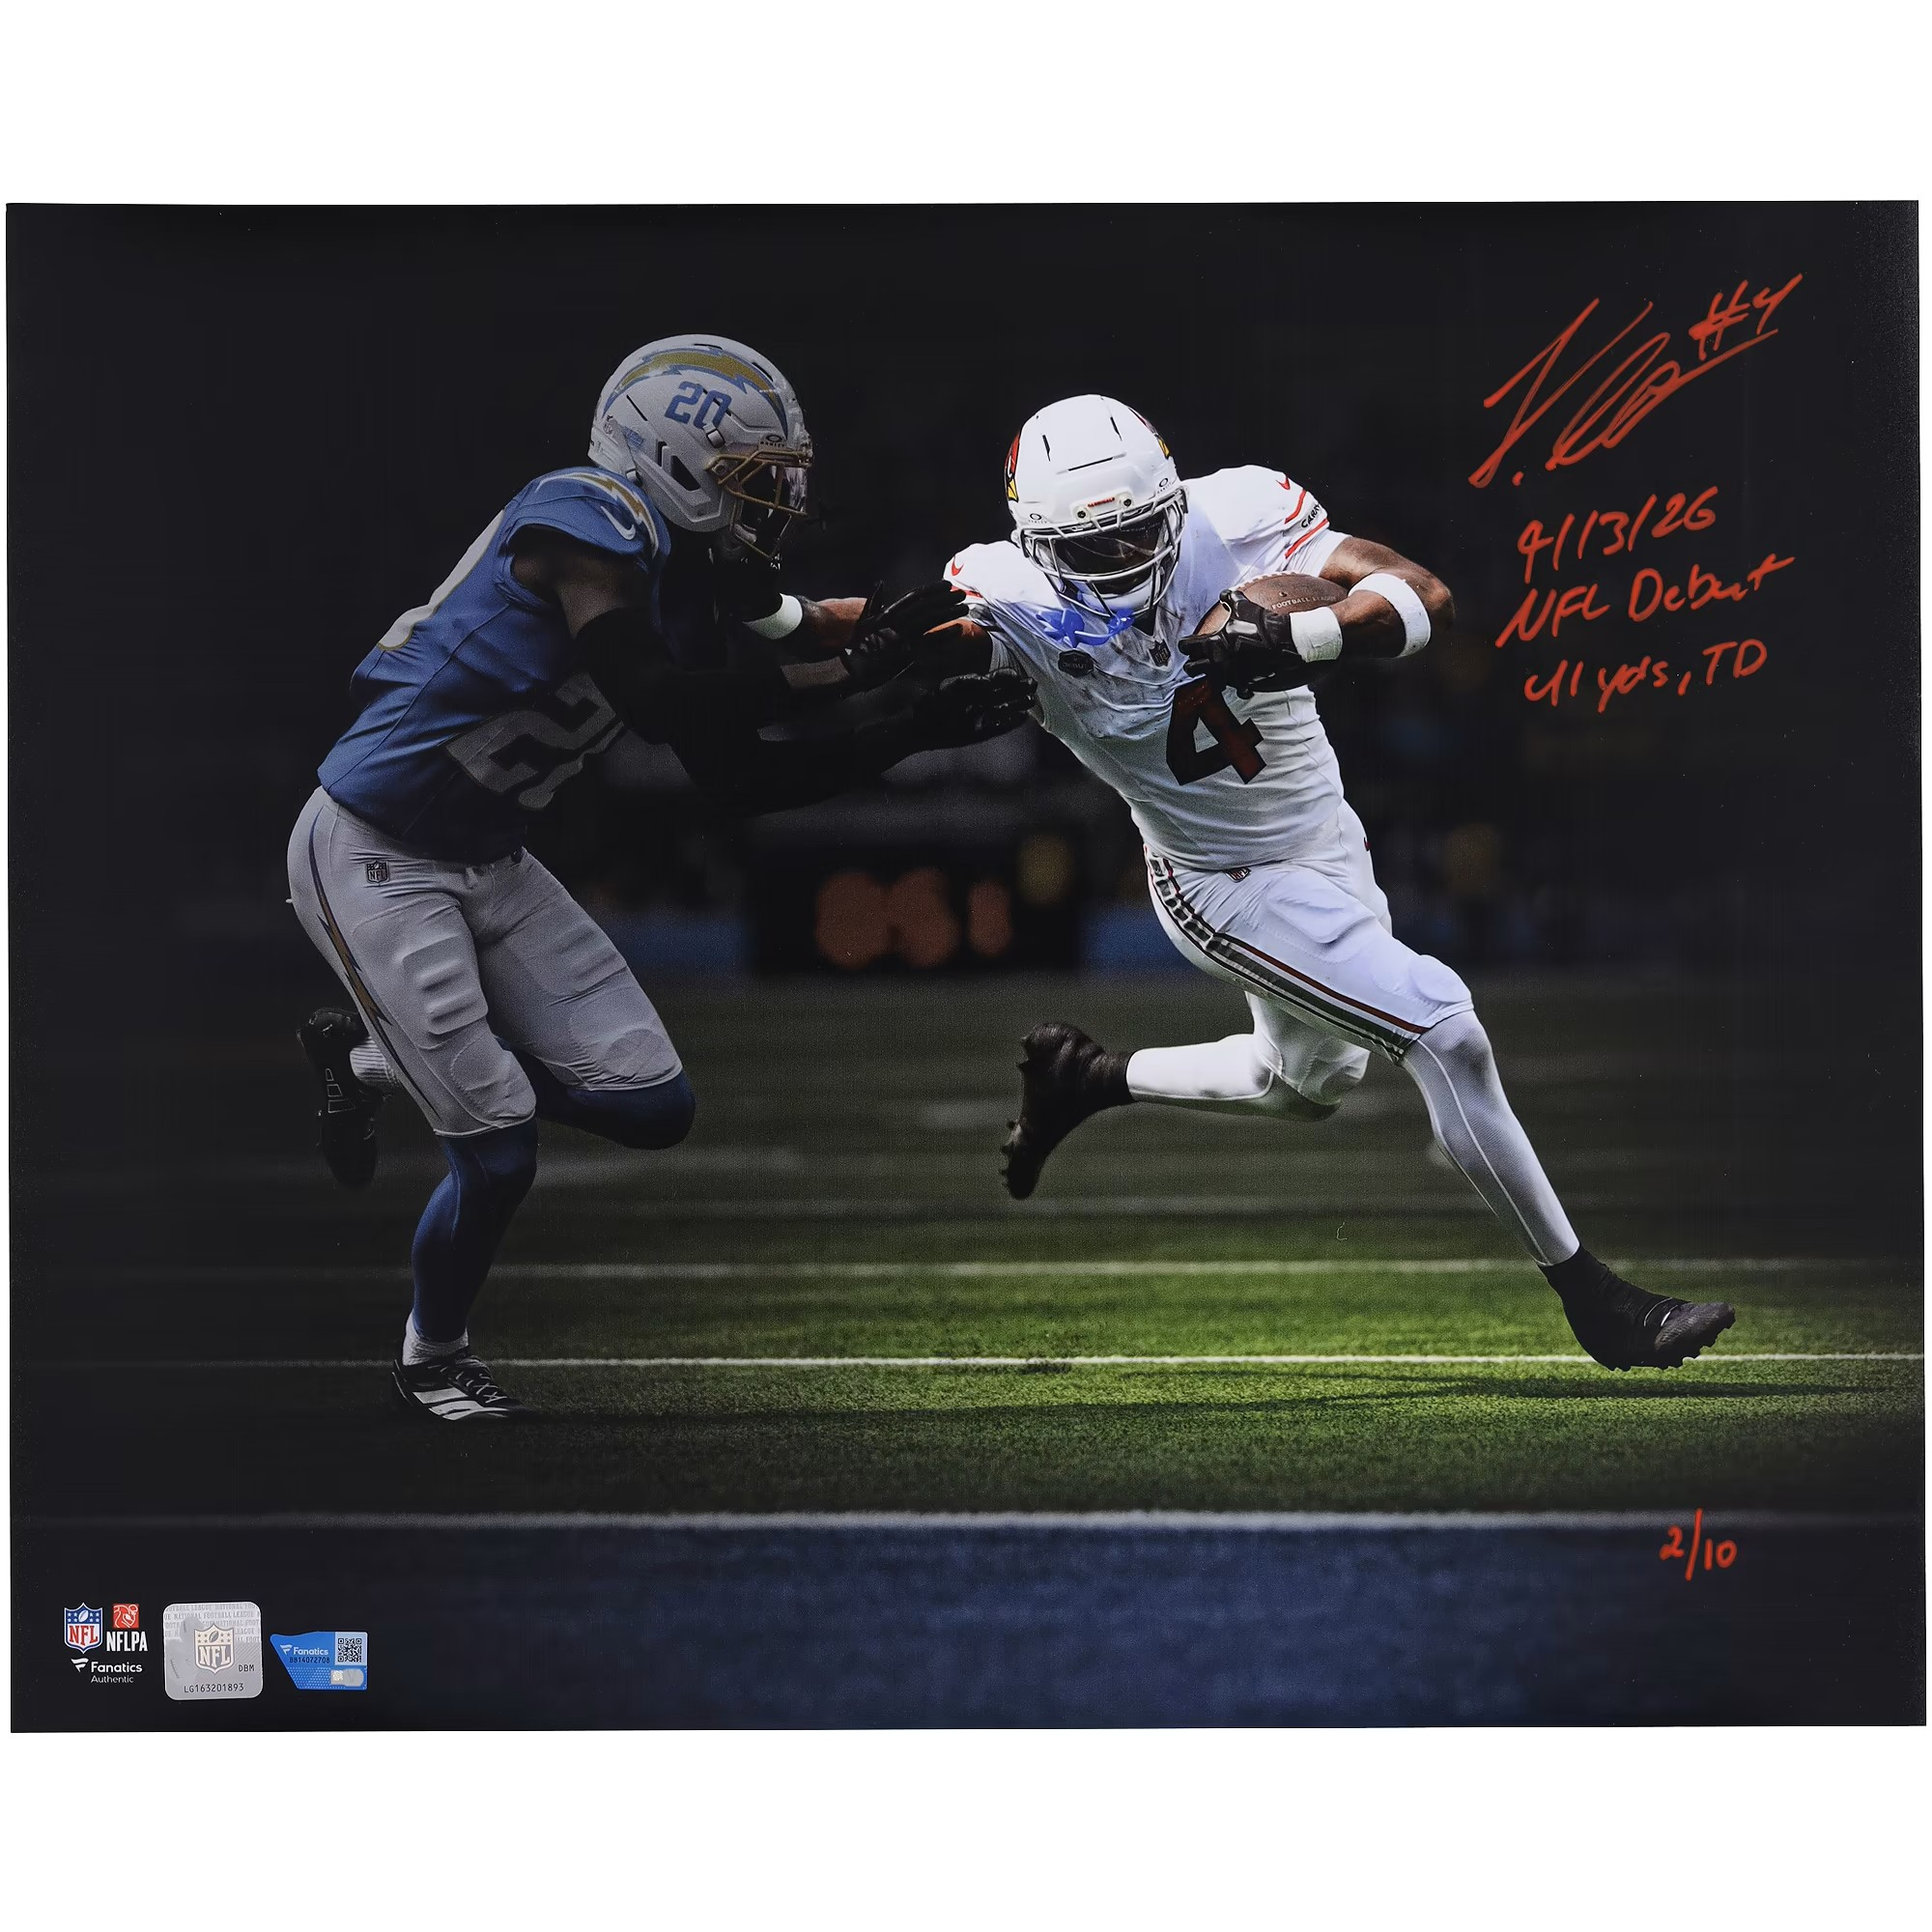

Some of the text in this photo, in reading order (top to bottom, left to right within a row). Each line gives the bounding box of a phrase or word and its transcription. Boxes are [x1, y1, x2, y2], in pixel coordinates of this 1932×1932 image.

[664, 381, 732, 432] 20
[1271, 597, 1311, 610] FOOTBALL
[1495, 554, 1795, 647] NFL Debut
[1702, 639, 1768, 685] TD
[1166, 678, 1267, 785] 4
[1659, 1508, 1738, 1582] 2/10
[70, 1625, 99, 1646] NFL
[106, 1631, 148, 1652] NFLPA
[199, 1646, 231, 1668] NFL
[293, 1647, 329, 1656] Fanatics
[91, 1662, 143, 1672] Fanatics
[91, 1674, 134, 1684] Authentic
[184, 1683, 244, 1693] LG163201893
